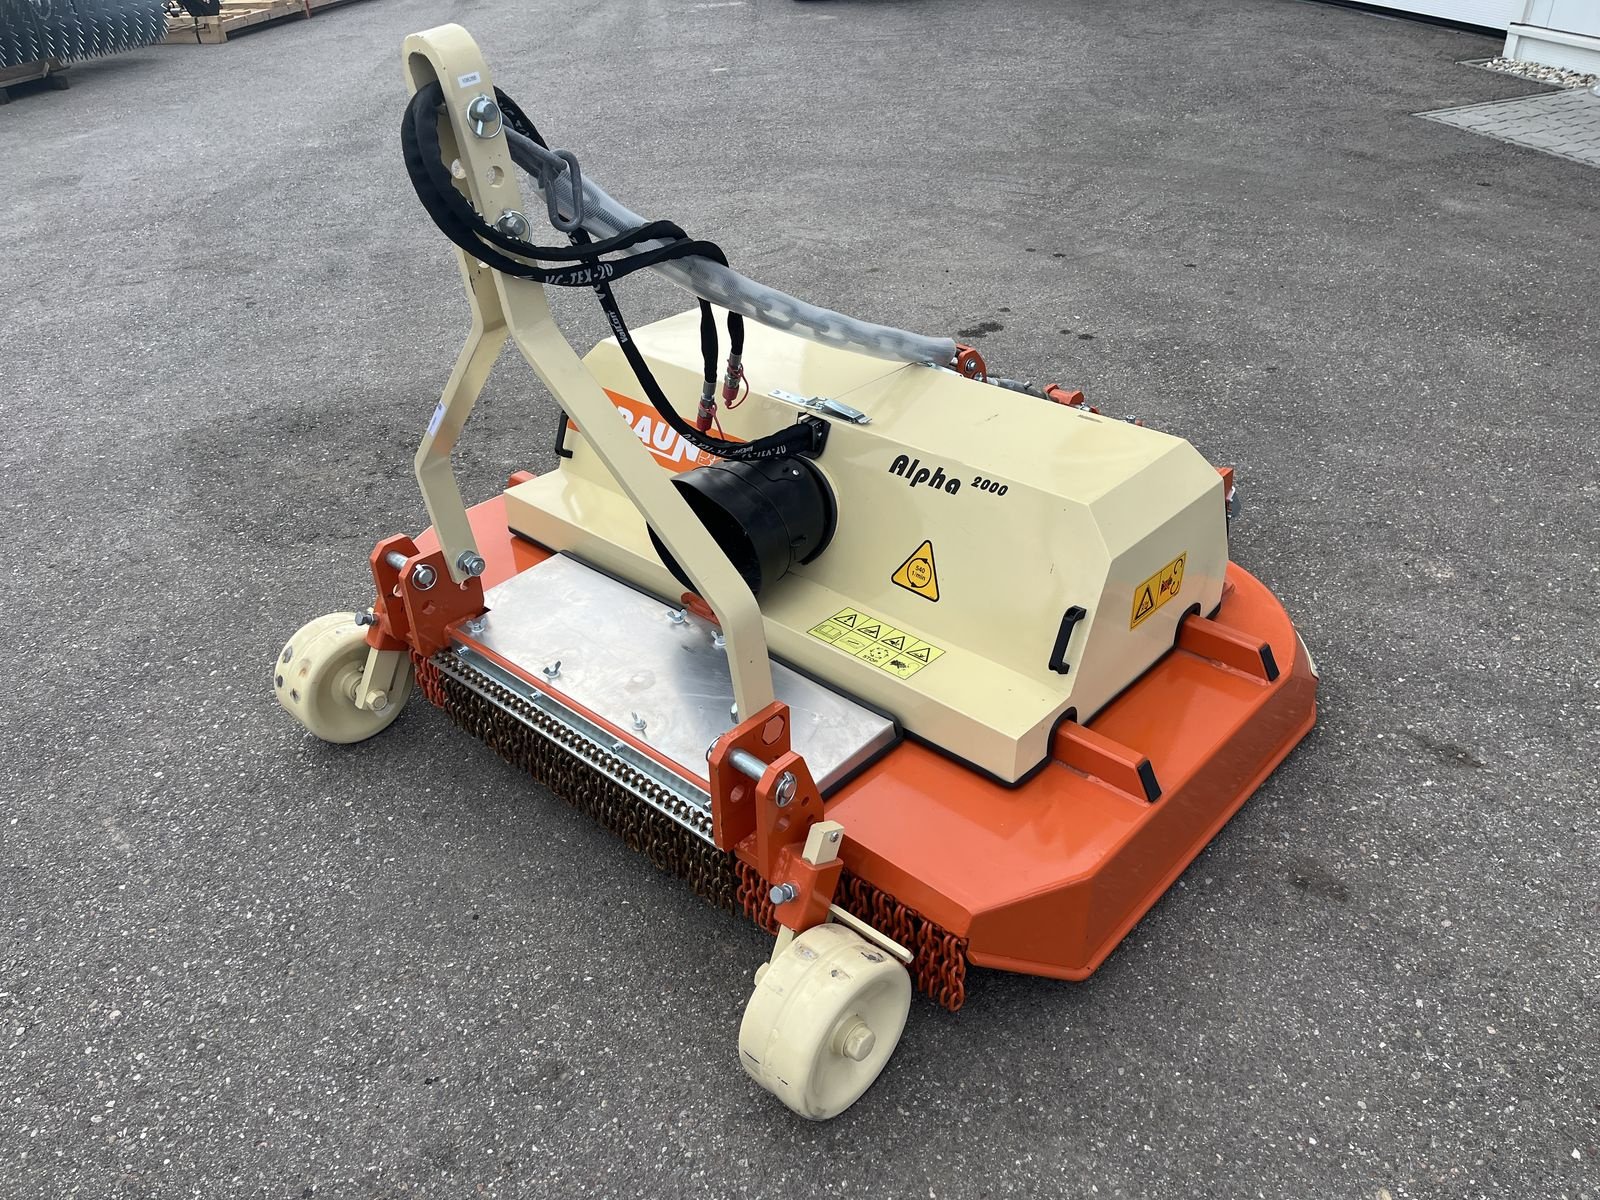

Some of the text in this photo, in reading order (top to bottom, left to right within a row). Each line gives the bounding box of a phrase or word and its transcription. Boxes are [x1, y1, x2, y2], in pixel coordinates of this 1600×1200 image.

[888, 454, 1009, 496] Alpha 2000
[862, 654, 879, 663] STOP
